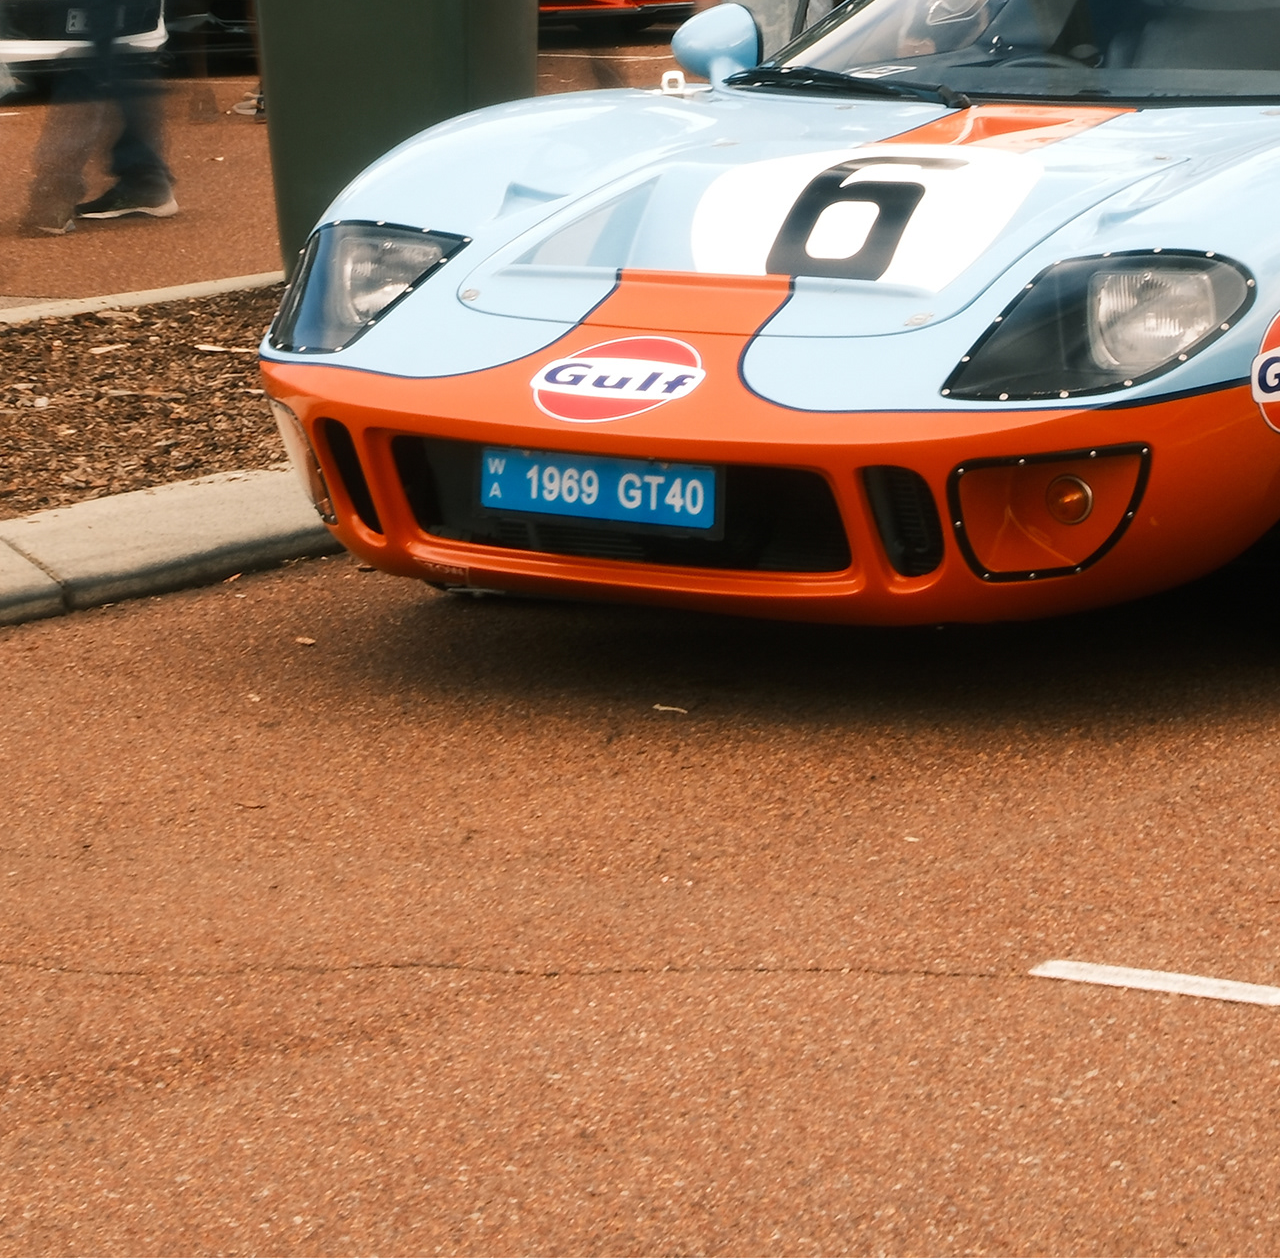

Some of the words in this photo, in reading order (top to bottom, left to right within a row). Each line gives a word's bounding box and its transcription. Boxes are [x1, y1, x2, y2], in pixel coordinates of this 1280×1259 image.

[765, 156, 970, 282] 6
[543, 363, 696, 394] Gulf
[526, 464, 600, 505] 1969
[617, 473, 705, 516] GT40
